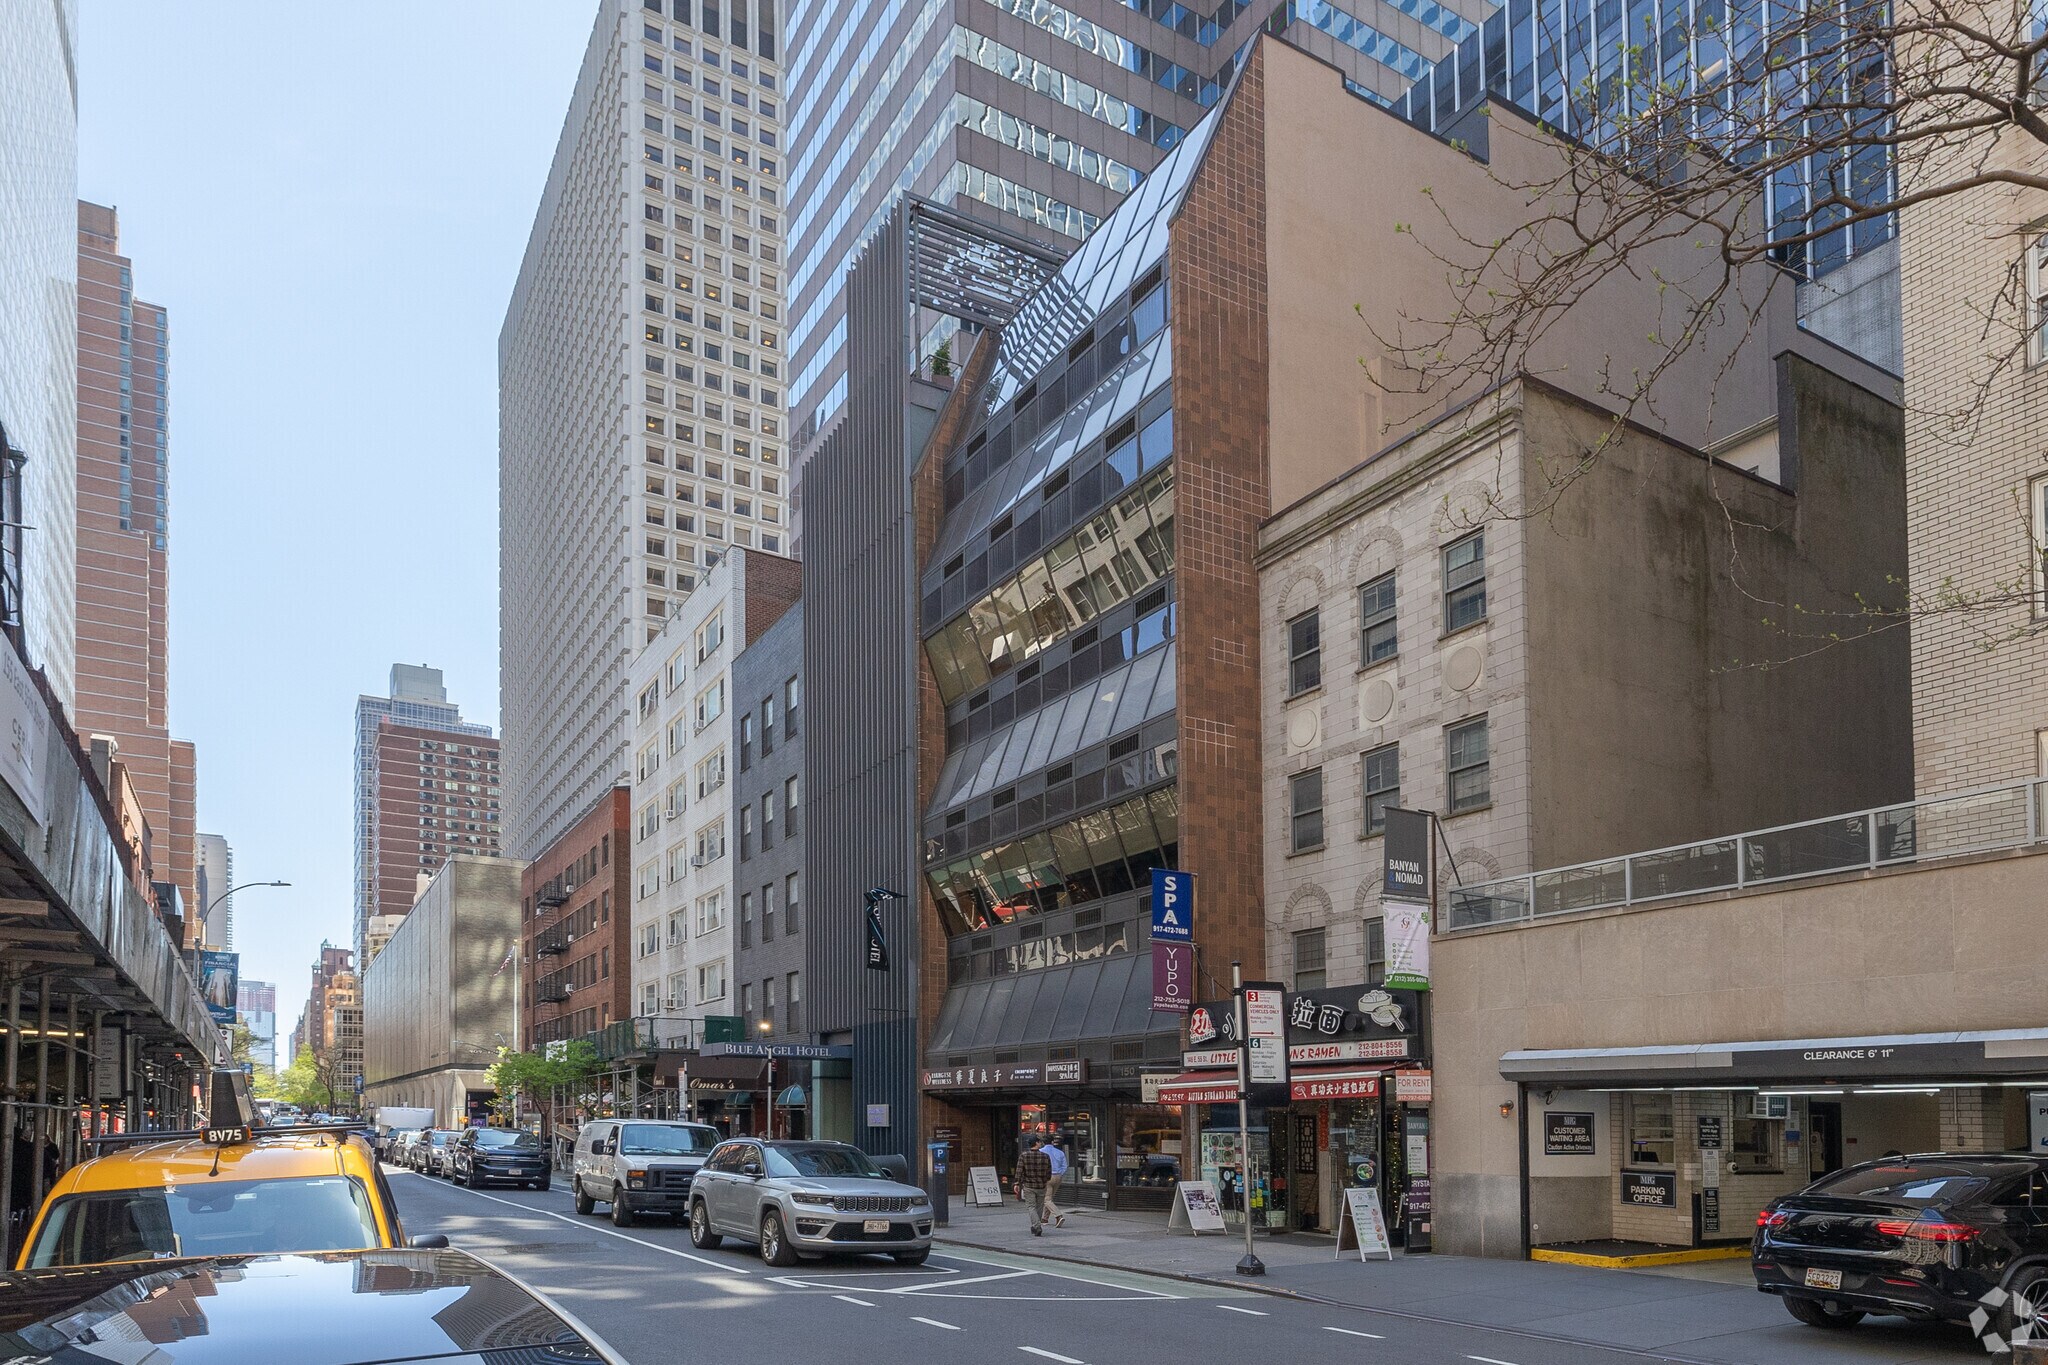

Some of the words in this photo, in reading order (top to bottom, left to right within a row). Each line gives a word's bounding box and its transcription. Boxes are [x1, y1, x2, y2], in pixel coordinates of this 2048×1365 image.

[1389, 859, 1419, 873] BANYAN
[1395, 872, 1423, 885] NOMAD
[1163, 876, 1178, 925] SPA
[1166, 947, 1178, 996] YUPO
[1250, 992, 1256, 1001] 3
[1252, 1039, 1259, 1048] 6
[725, 1044, 753, 1054] BLUE
[796, 1046, 832, 1056] HOTEL
[1210, 1052, 1236, 1063] LITTLE
[1307, 1046, 1340, 1058] RAMEN
[1803, 1049, 1865, 1060] CLEARANCE
[1121, 1067, 1135, 1076] 150
[689, 1078, 735, 1089] Omar's
[1398, 1079, 1411, 1087] FOR
[1413, 1079, 1430, 1087] RENT
[1188, 1092, 1203, 1101] LITTLE
[208, 1129, 243, 1142] 8V75
[1553, 1127, 1586, 1135] CUSTOMER
[937, 1149, 944, 1158] P
[1630, 1185, 1666, 1195] PARKING
[1633, 1194, 1663, 1204] OFFICE
